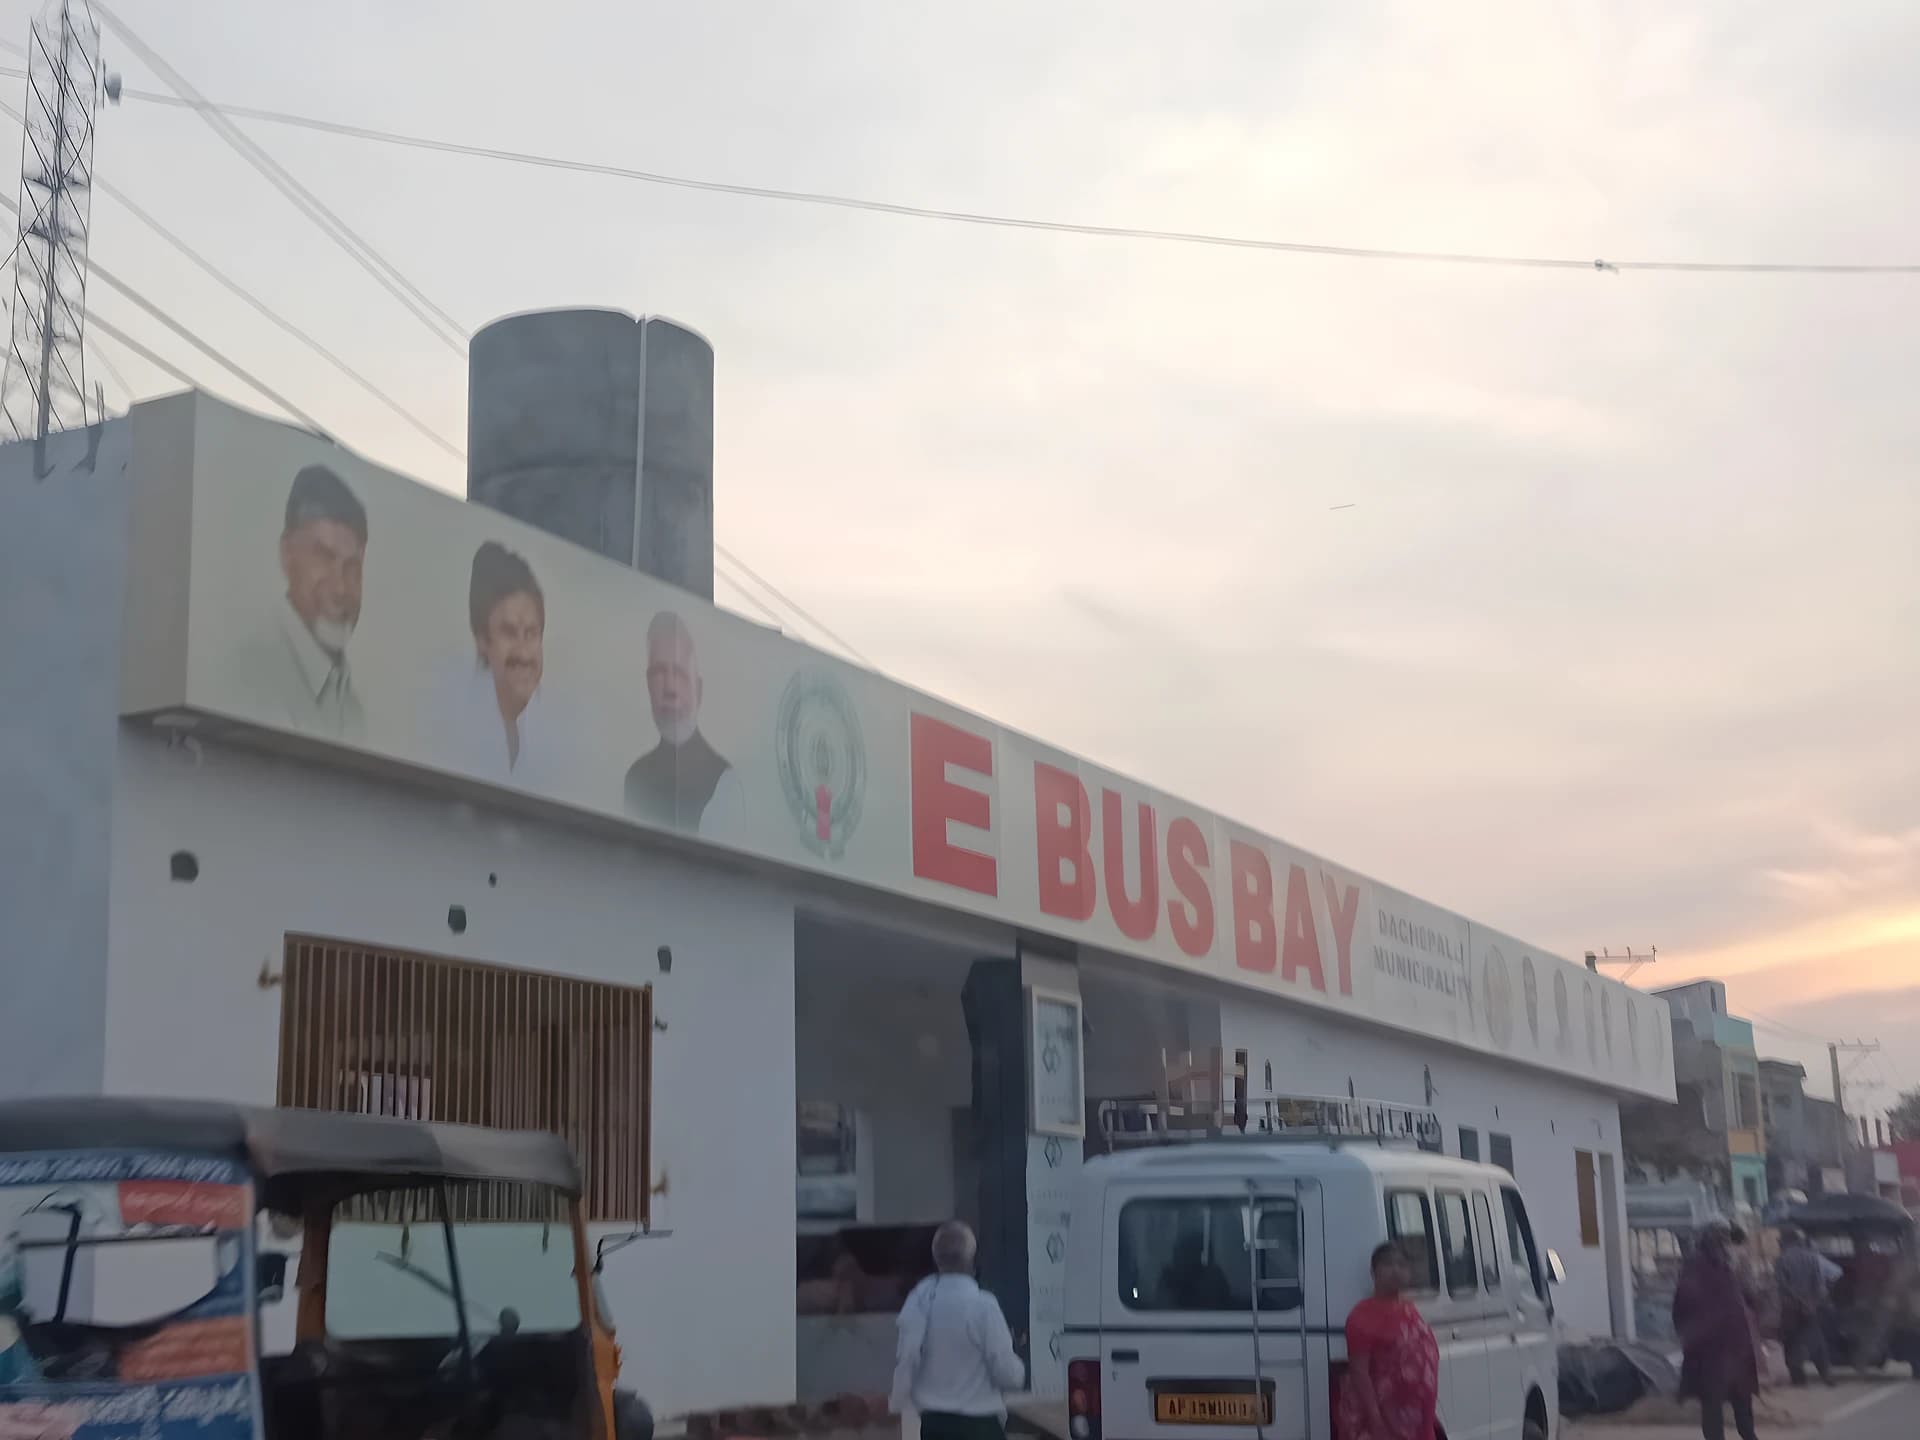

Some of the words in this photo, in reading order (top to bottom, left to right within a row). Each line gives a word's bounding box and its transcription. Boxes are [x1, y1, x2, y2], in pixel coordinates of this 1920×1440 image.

[910, 711, 998, 898] E
[1034, 760, 1216, 958] BUS
[1230, 838, 1361, 996] BAY
[1373, 945, 1473, 1000] MUNICIPALITY
